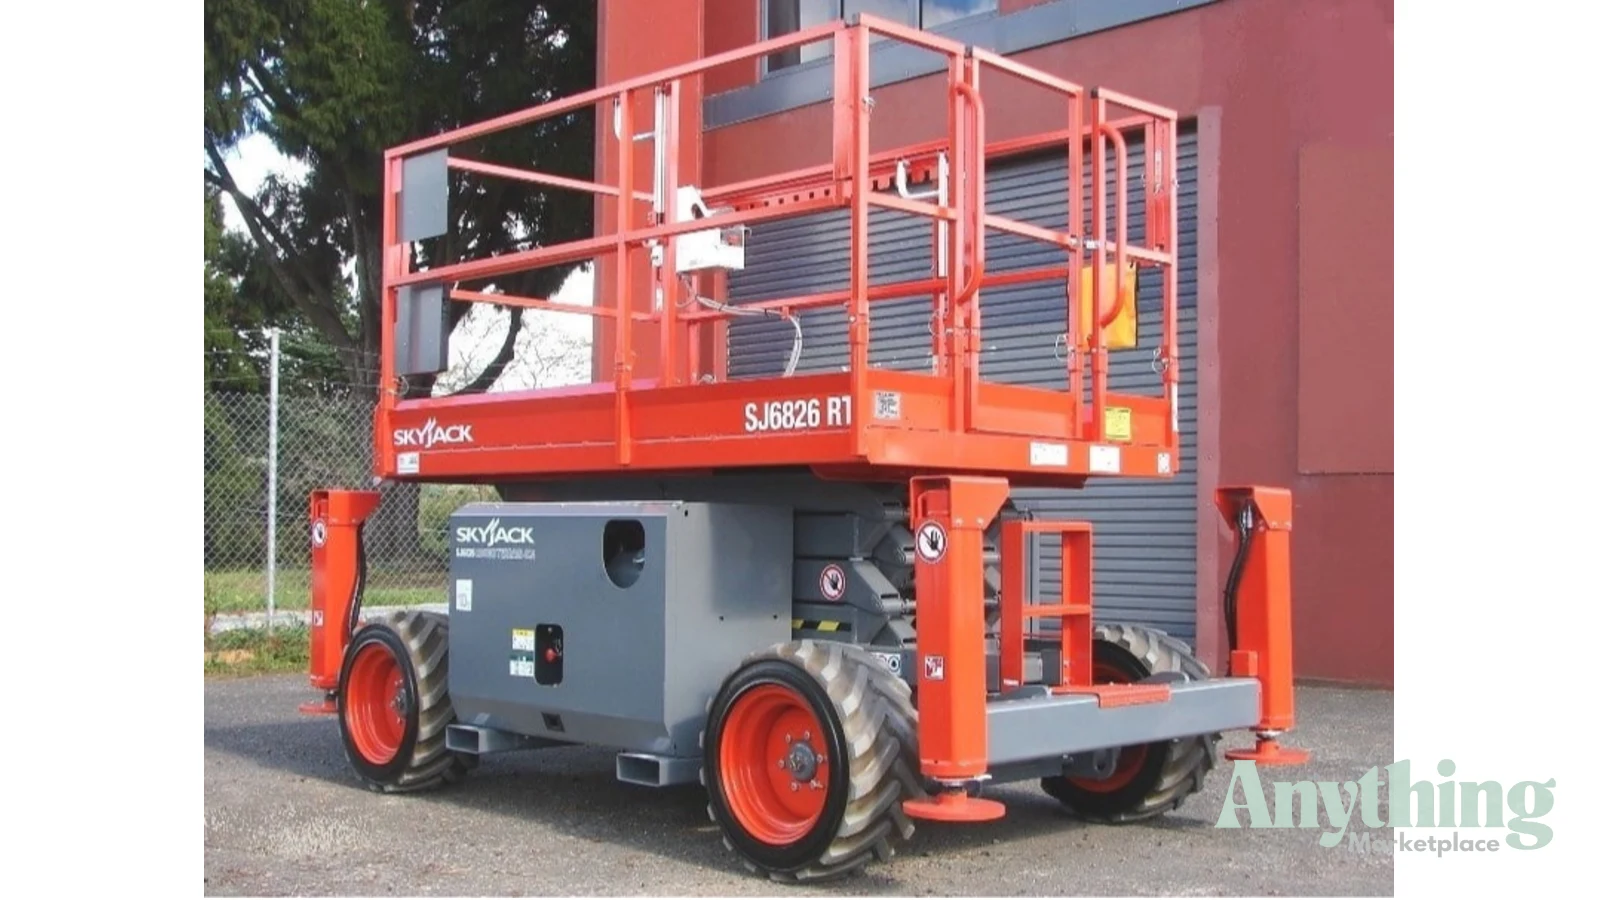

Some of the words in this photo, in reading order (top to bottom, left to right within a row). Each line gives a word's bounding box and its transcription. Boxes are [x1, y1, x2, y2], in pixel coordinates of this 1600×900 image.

[745, 399, 820, 431] SJ6826
[394, 417, 474, 448] SKYJACK
[456, 517, 534, 547] SKYJACK
